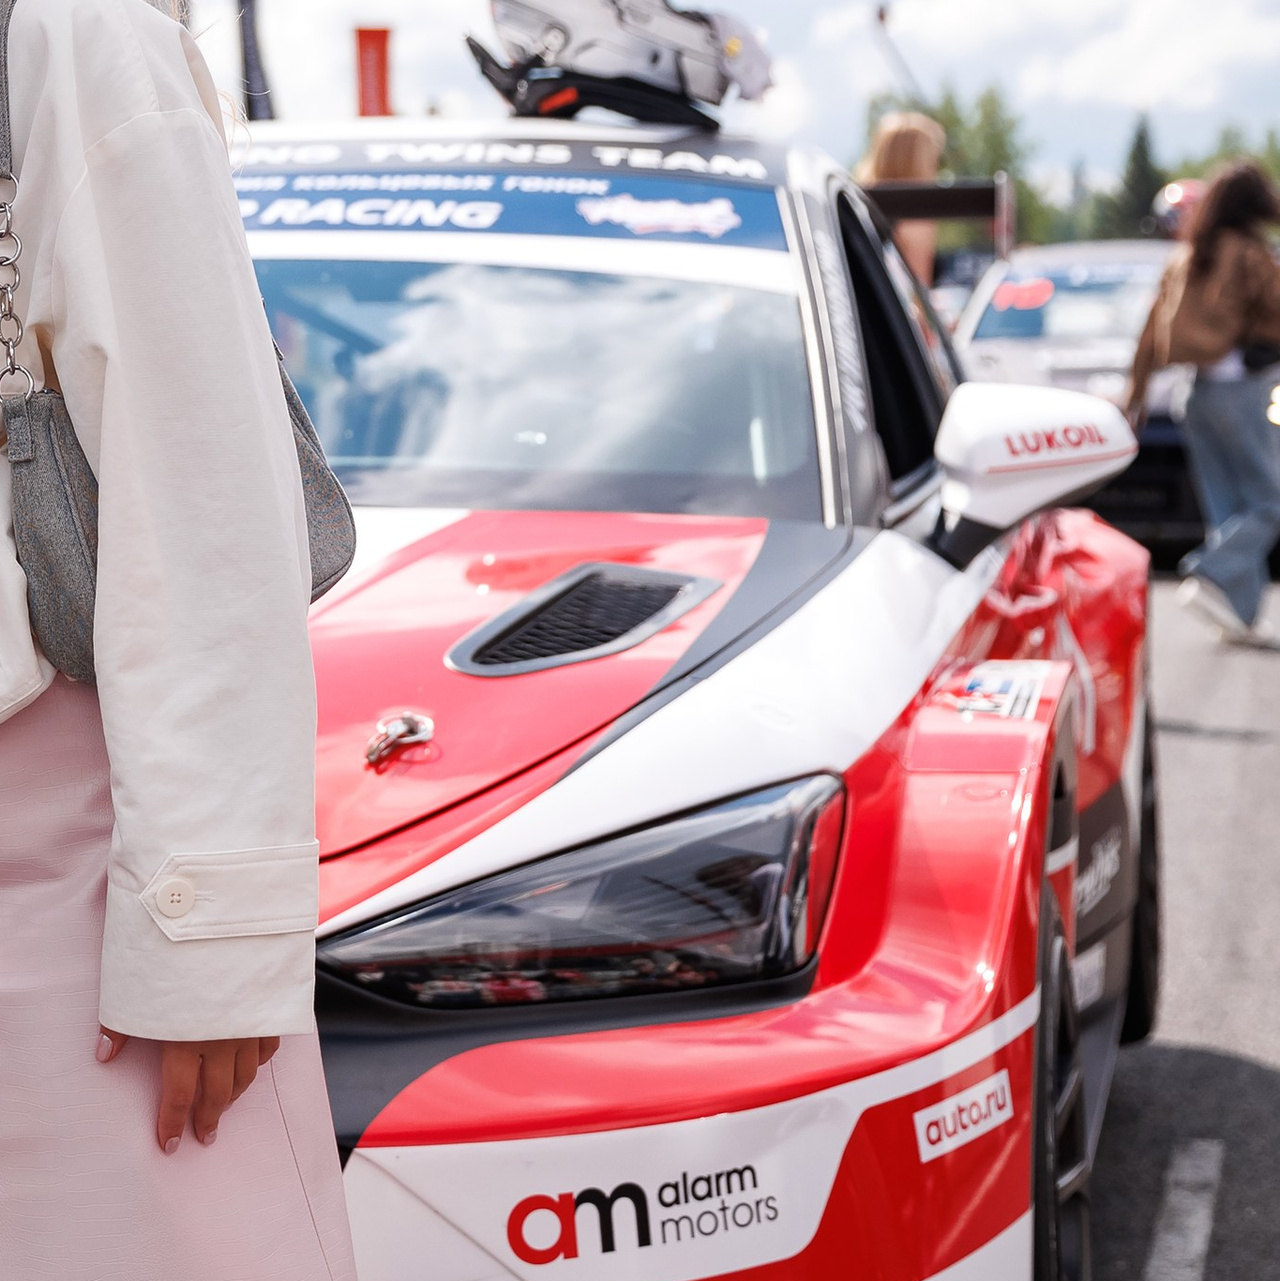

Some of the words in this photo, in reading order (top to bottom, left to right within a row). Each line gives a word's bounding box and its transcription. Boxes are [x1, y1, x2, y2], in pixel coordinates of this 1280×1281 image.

[592, 146, 768, 180] TEAM
[258, 197, 505, 228] RACING
[1004, 423, 1108, 457] LUKOIL
[926, 1085, 1007, 1146] auto.ru
[657, 1165, 758, 1208] alarm
[661, 1196, 779, 1244] motors
